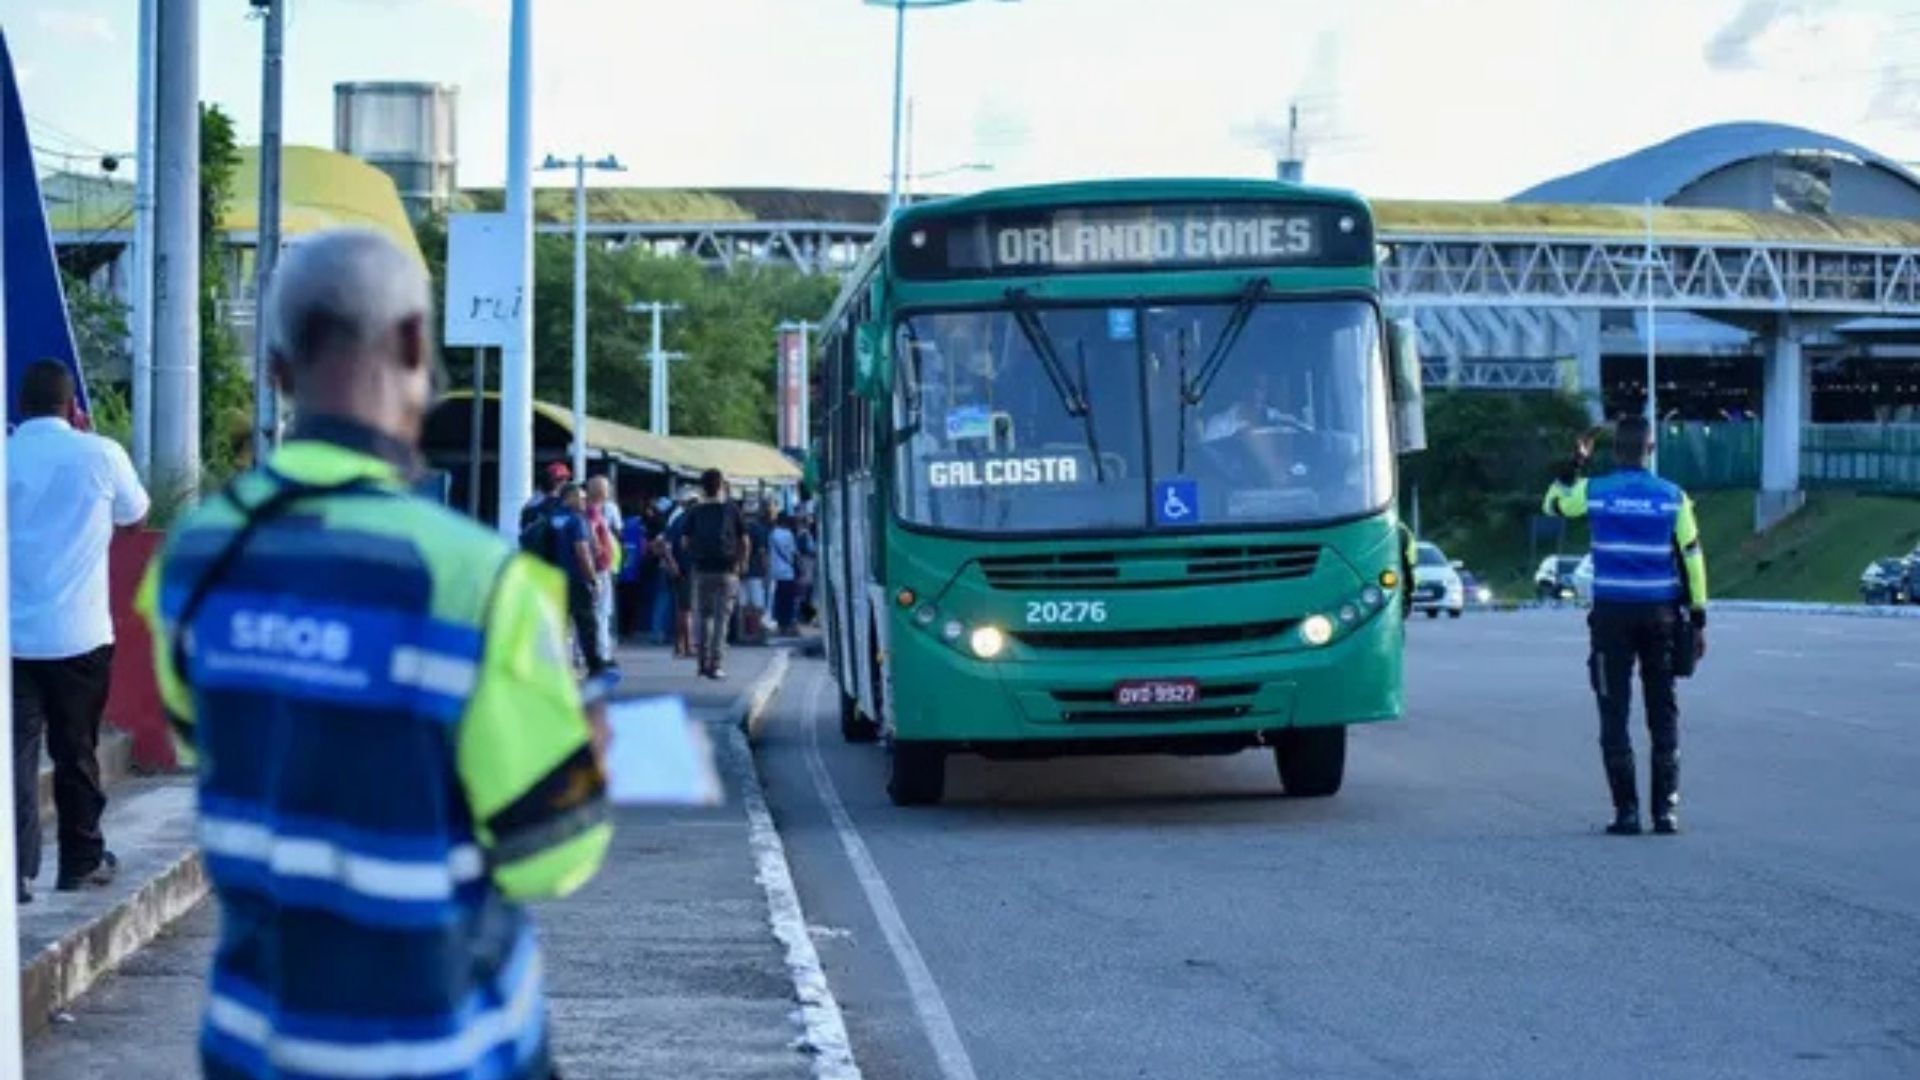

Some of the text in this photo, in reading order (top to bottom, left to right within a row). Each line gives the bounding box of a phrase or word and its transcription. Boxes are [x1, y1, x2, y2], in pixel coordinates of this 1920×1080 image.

[998, 217, 1310, 265] ORLANDO GOMES
[930, 455, 1077, 488] GAL COSTA
[1026, 601, 1107, 622] 20276
